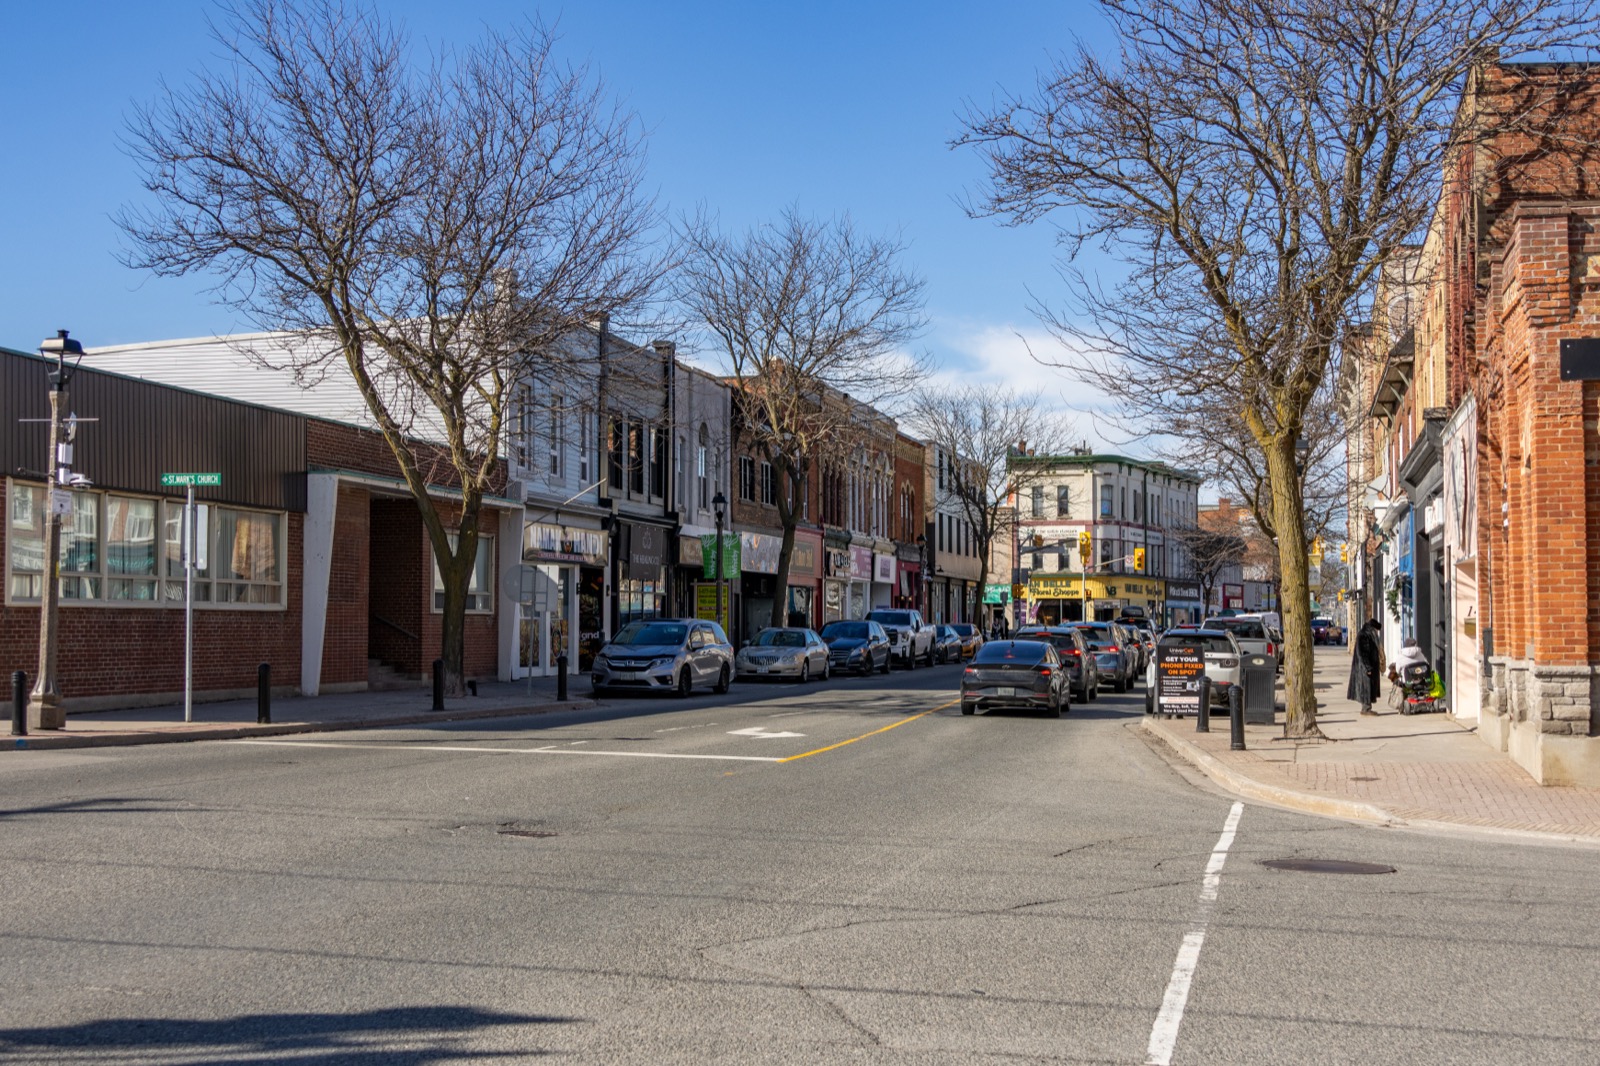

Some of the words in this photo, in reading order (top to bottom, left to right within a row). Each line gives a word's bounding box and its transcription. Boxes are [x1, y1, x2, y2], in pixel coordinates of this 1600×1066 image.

[198, 475, 218, 484] CHURCH
[530, 526, 562, 554] NAMAK
[573, 531, 602, 555] HANDI
[1053, 588, 1080, 597] Shoppe
